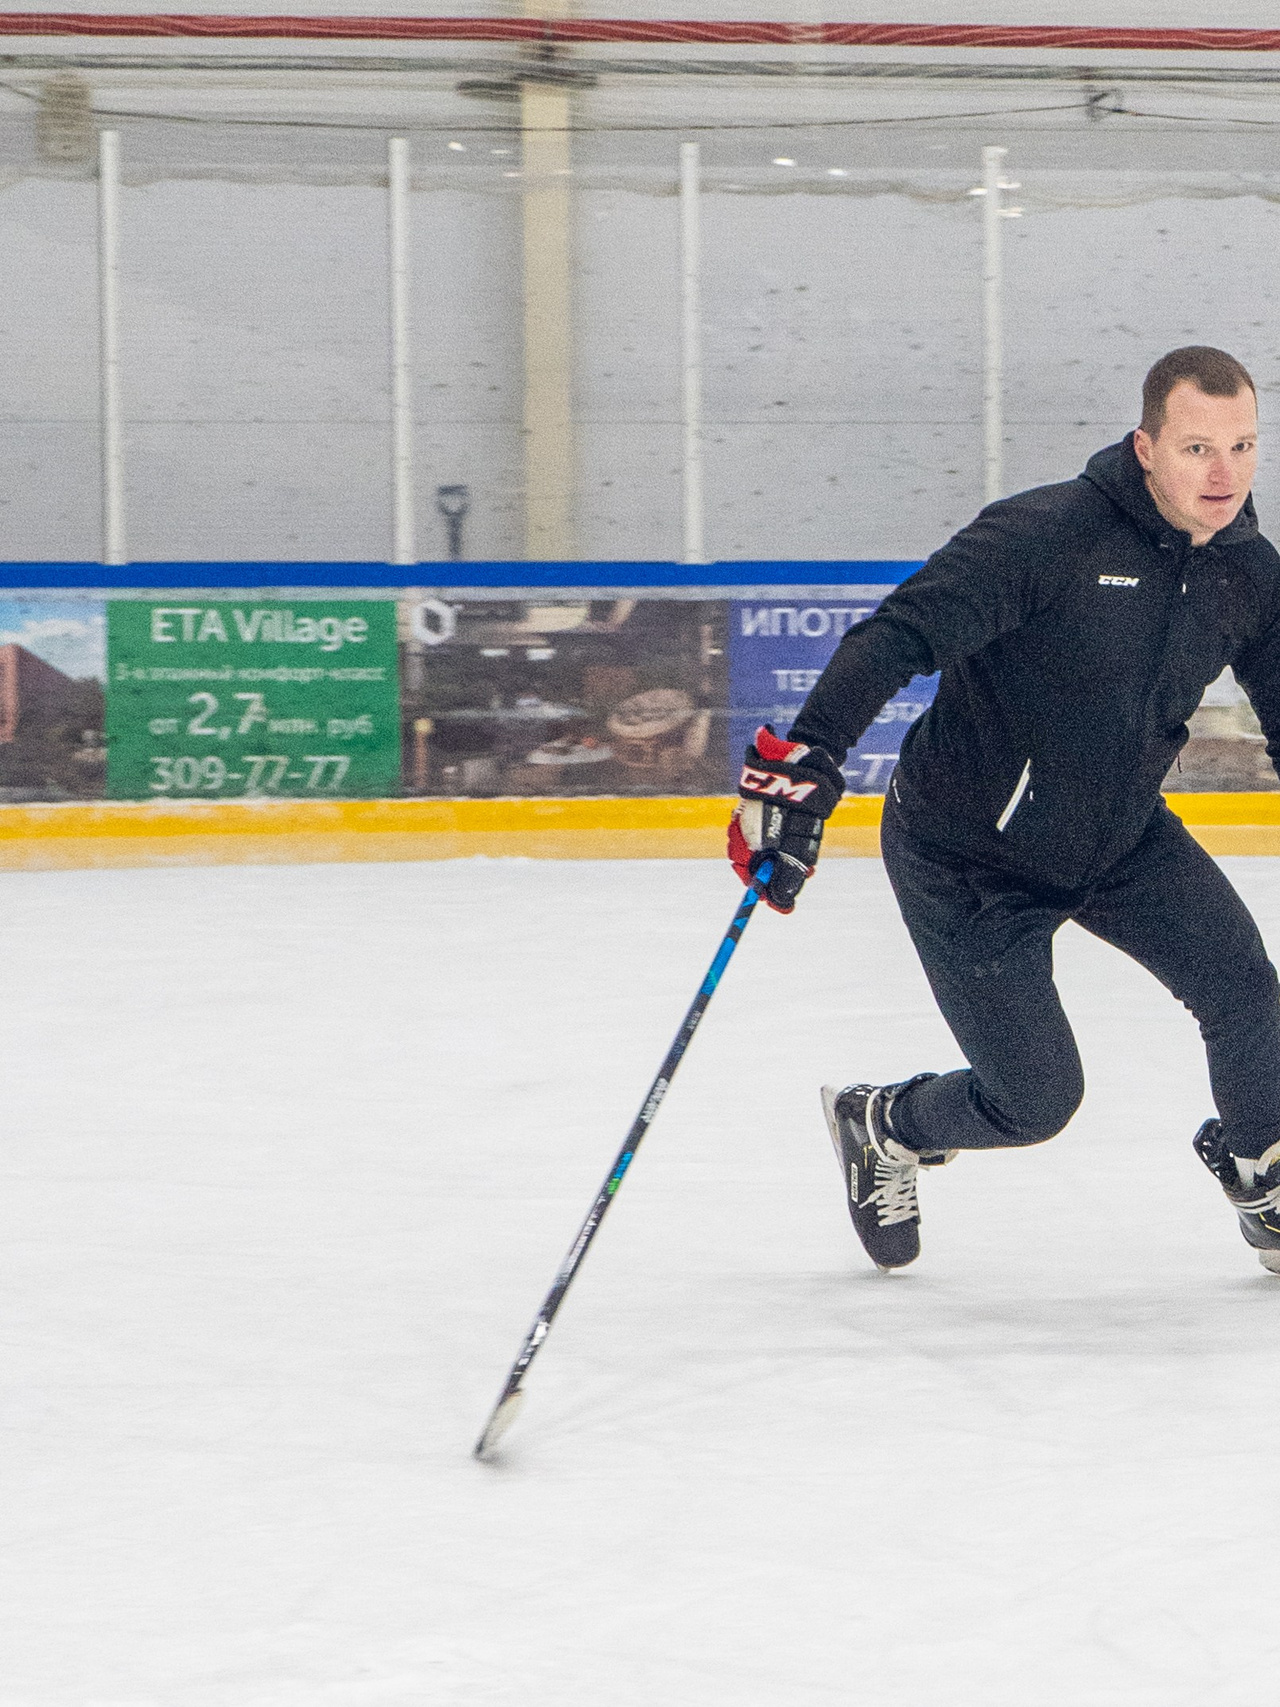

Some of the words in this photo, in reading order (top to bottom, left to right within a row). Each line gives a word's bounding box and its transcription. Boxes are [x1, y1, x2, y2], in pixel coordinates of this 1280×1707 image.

[151, 608, 228, 643] ETA
[233, 607, 368, 651] Village
[149, 717, 181, 736] от
[187, 692, 268, 740] 2,7
[149, 755, 351, 792] 309-77-77
[739, 765, 818, 802] CM
